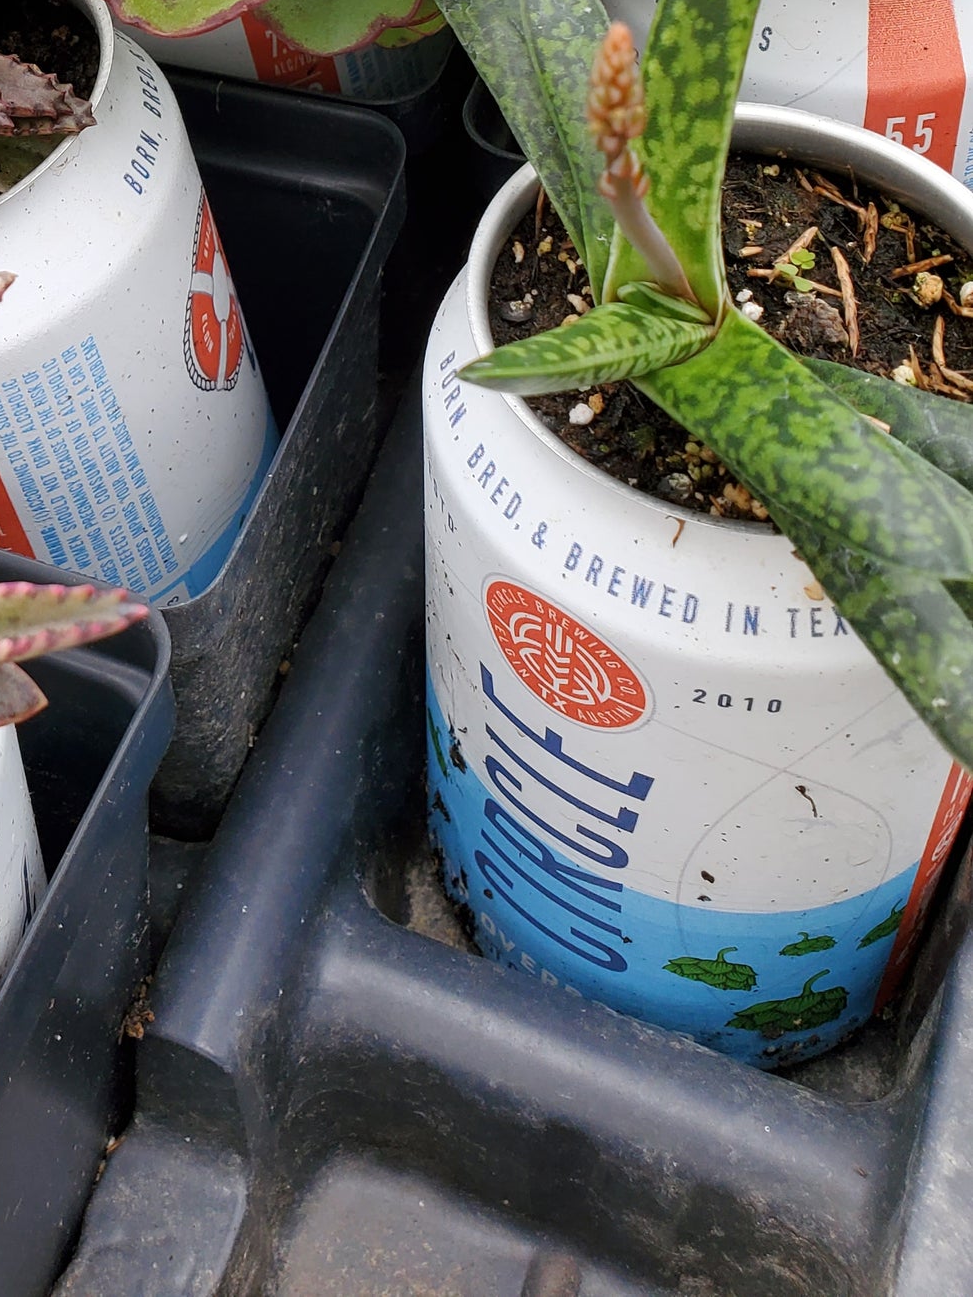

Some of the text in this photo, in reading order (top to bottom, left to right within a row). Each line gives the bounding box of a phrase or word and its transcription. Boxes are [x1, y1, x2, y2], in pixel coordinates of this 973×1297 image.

[137, 65, 162, 118] BRED,
[123, 130, 163, 195] BORN,
[22, 370, 39, 385] OF
[27, 382, 48, 408] RISK
[42, 358, 76, 417] ALCOHOLIC
[1, 379, 37, 433] ALCOHOLIC
[37, 405, 56, 427] THE
[99, 385, 122, 423] HEALTH
[45, 427, 62, 440] OF
[66, 419, 82, 433] OF
[112, 422, 133, 452] CAUSE
[25, 436, 50, 469] DRINK
[50, 438, 78, 480] BECAUSE
[61, 345, 163, 585] BEVERAGES IMPAIRS YOUR ABILITY TO DRIVE A CAR OR
[72, 432, 110, 504] CONSUMPTION
[123, 449, 140, 472] MAY
[40, 472, 61, 493] NOT
[131, 468, 147, 489] AND
[439, 350, 848, 639] BORN, BRED, & BREWED IN TEX
[50, 495, 77, 533] SHOULD
[67, 479, 98, 530] PREGNANCY
[100, 504, 119, 522] (2)
[67, 535, 92, 570] WOMEN
[87, 527, 111, 561] DURING
[155, 535, 179, 574] OPERATE
[491, 588, 529, 613] CIRCLE
[535, 600, 621, 669] BREWING
[494, 624, 634, 725] ELGIN TX AUSTIN
[692, 688, 784, 714] 2010
[474, 661, 655, 973] CIRCLE
